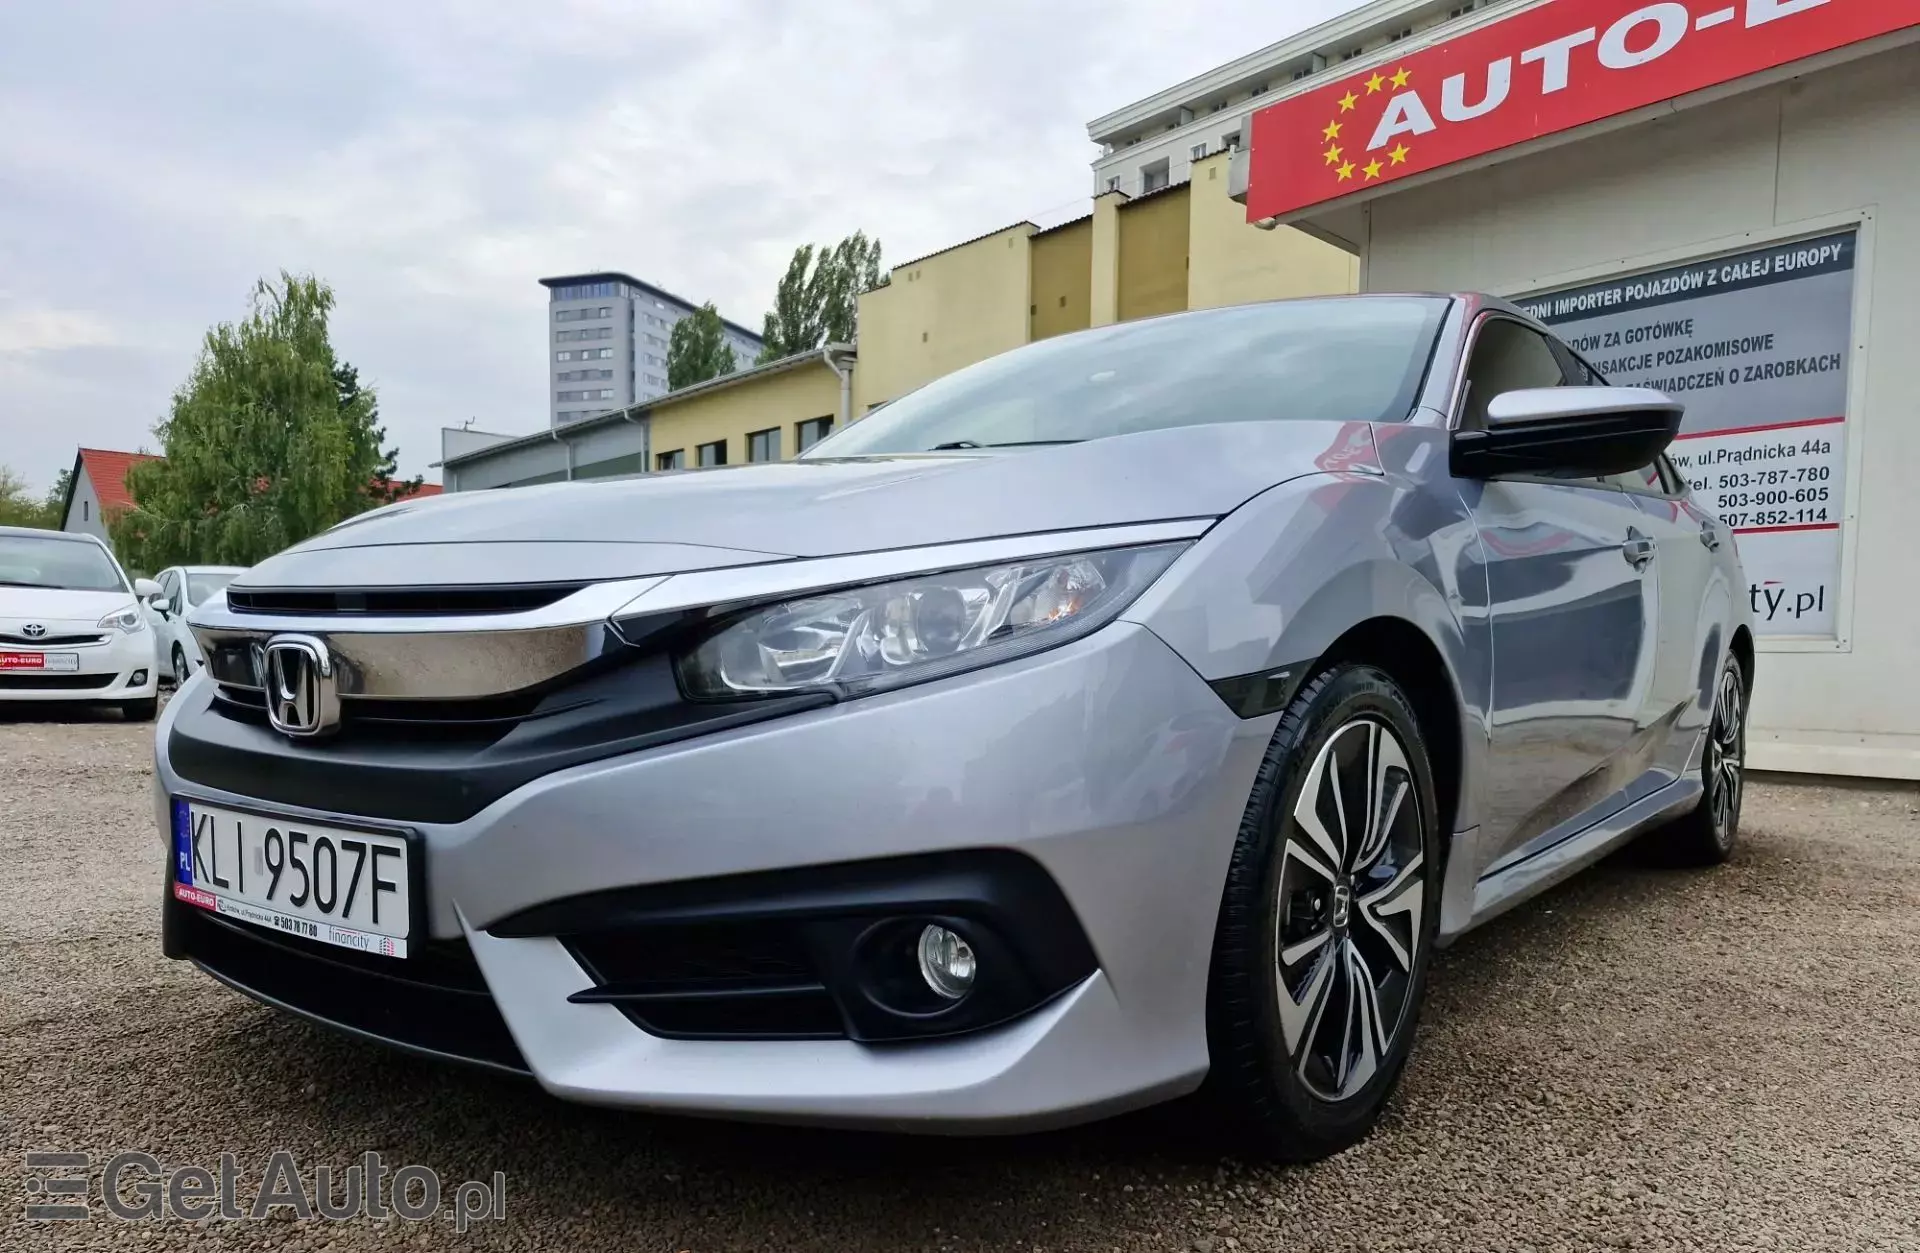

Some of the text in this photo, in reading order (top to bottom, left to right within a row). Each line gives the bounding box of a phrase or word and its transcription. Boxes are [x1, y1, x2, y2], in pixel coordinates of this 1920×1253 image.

[1555, 284, 1621, 315] IMPORTER
[1625, 270, 1703, 302] POJAZDÓW
[1707, 268, 1717, 286] Z
[1721, 257, 1770, 283] CAŁEJ
[1774, 243, 1841, 273] EUROPY
[1567, 318, 1694, 352] DÓW ZA GOTÓWKĘ
[1656, 333, 1774, 367] POZAKOMISOWE
[1729, 368, 1739, 384] O
[1743, 353, 1841, 382] ZAROBKACH
[1698, 446, 1796, 466] ul.Prądnicka
[1801, 439, 1831, 454] 44a
[1719, 466, 1830, 489] 503-787-780
[1718, 487, 1829, 508] 503-900-605
[1719, 507, 1828, 527] 507-852-114
[180, 851, 191, 871] PL
[190, 811, 401, 925] KLI 9507F
[179, 887, 215, 907] AUTO-EURO
[280, 917, 293, 931] 503
[328, 925, 370, 952] financity
